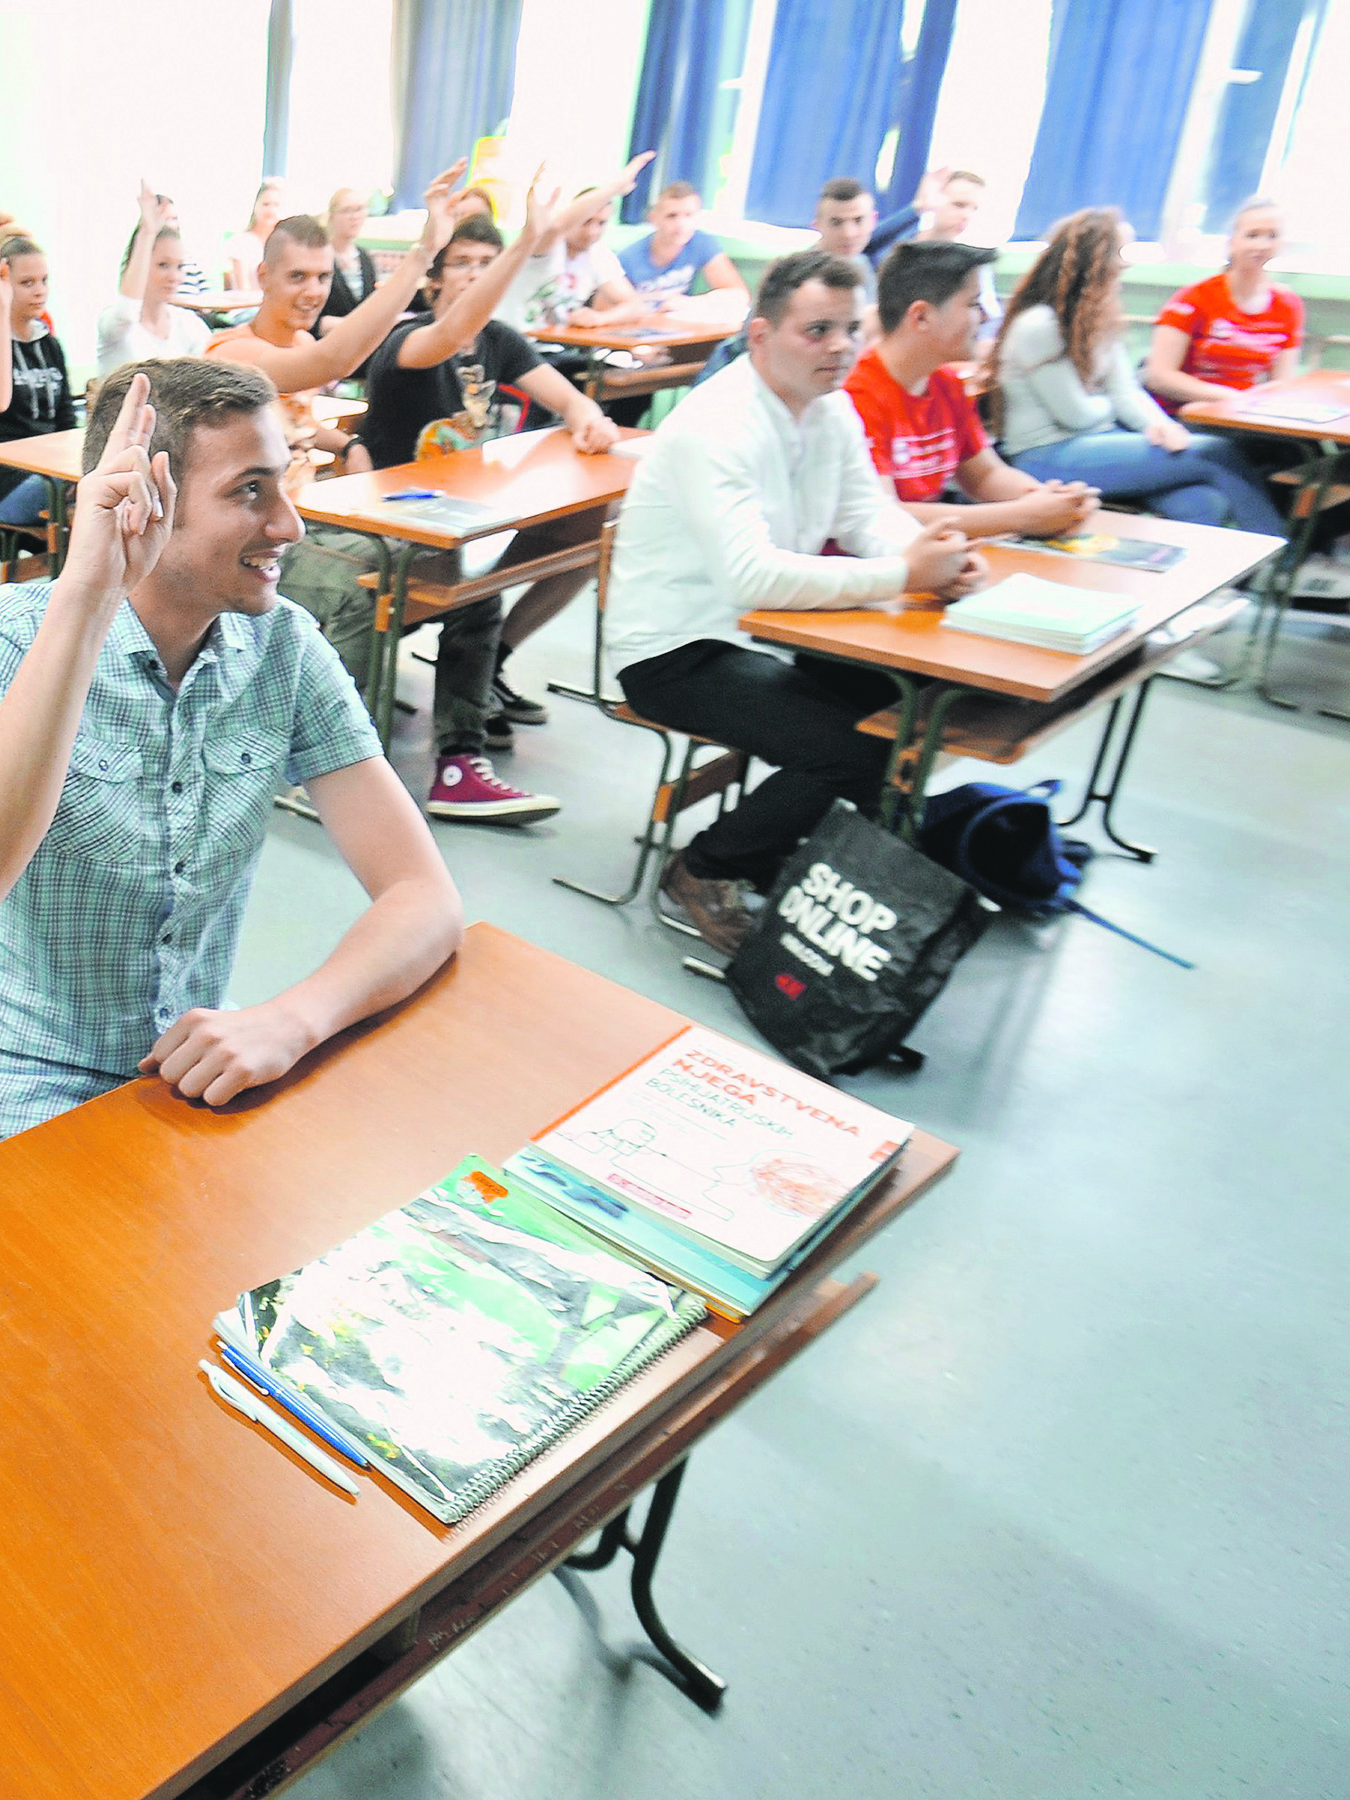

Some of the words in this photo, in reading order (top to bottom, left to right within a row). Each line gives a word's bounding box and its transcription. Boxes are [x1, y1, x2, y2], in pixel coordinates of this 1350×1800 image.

[777, 884, 892, 982] ONLINE
[801, 862, 898, 934] SHOP
[644, 1076, 738, 1128] BOLESNIKA
[671, 1058, 758, 1105] NJEGA
[685, 1049, 860, 1137] ZDRAVSTVENA
